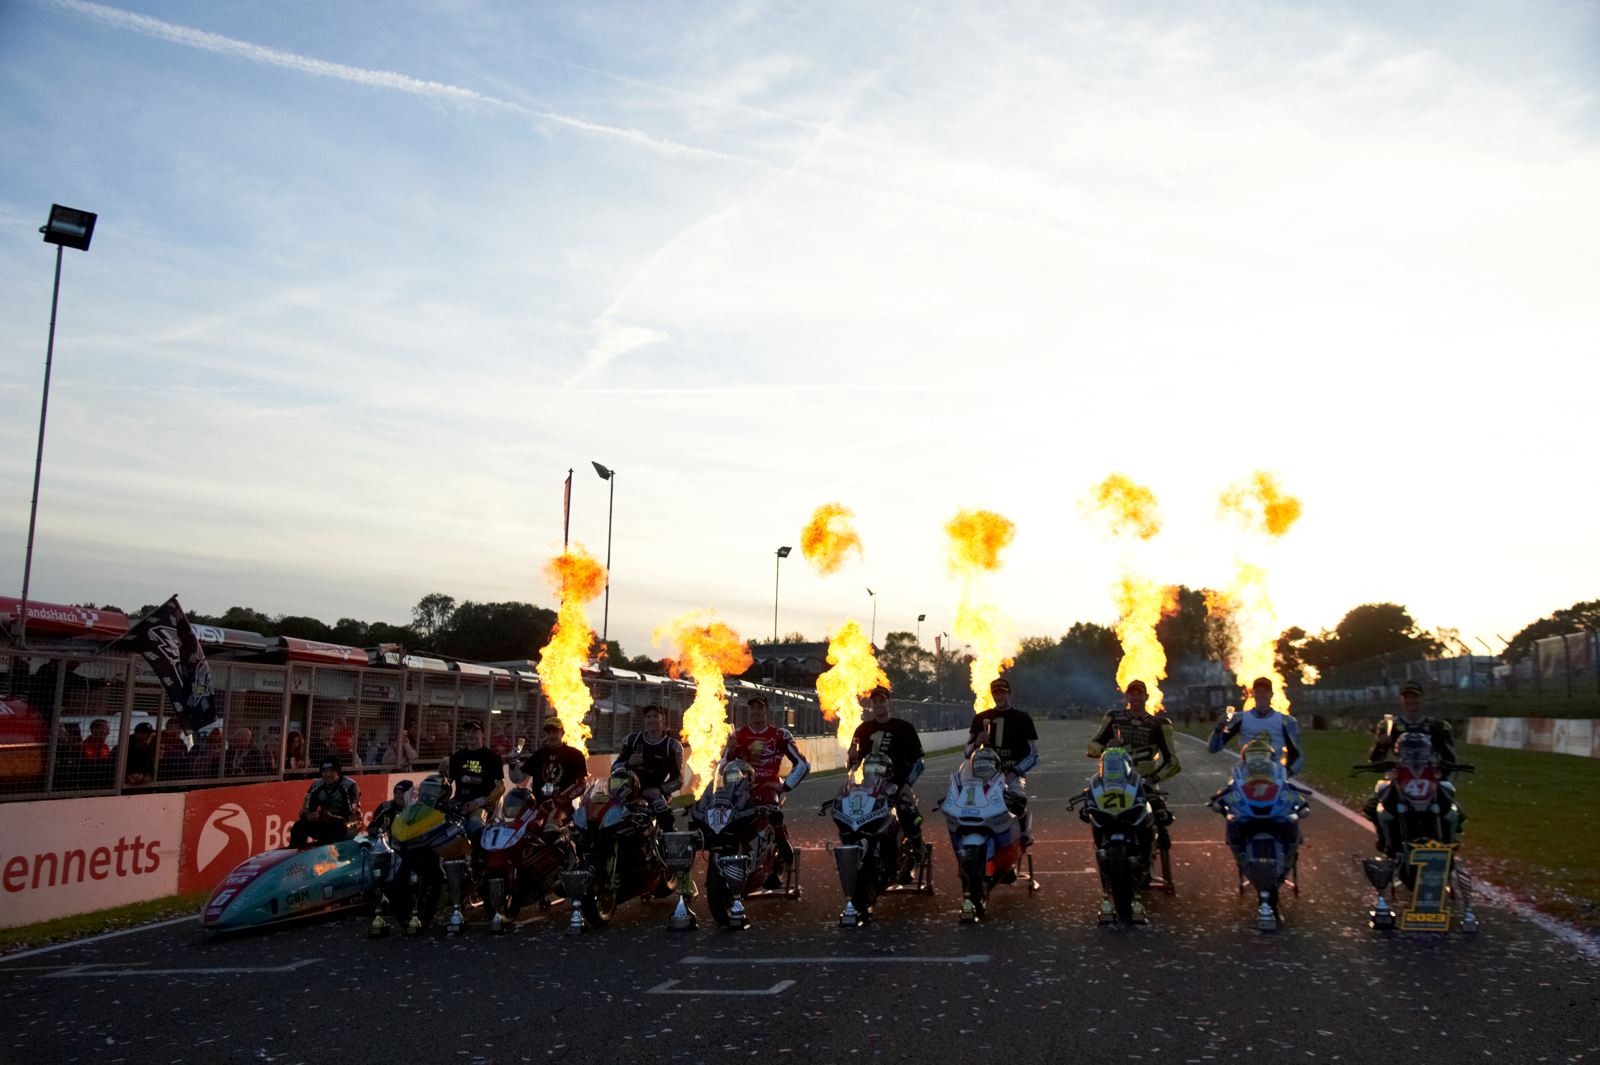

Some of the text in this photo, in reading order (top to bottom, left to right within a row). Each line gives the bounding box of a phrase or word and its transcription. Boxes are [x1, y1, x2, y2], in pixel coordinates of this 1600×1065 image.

[16, 604, 78, 622] BandsHatch
[965, 786, 977, 806] 1
[1404, 778, 1430, 796] 47
[1103, 793, 1126, 809] 21
[490, 829, 501, 847] 1
[0, 835, 161, 892] ennetts
[210, 888, 238, 907] 6
[231, 893, 250, 911] SWC
[286, 890, 310, 905] GBM
[1406, 913, 1446, 922] 2023
